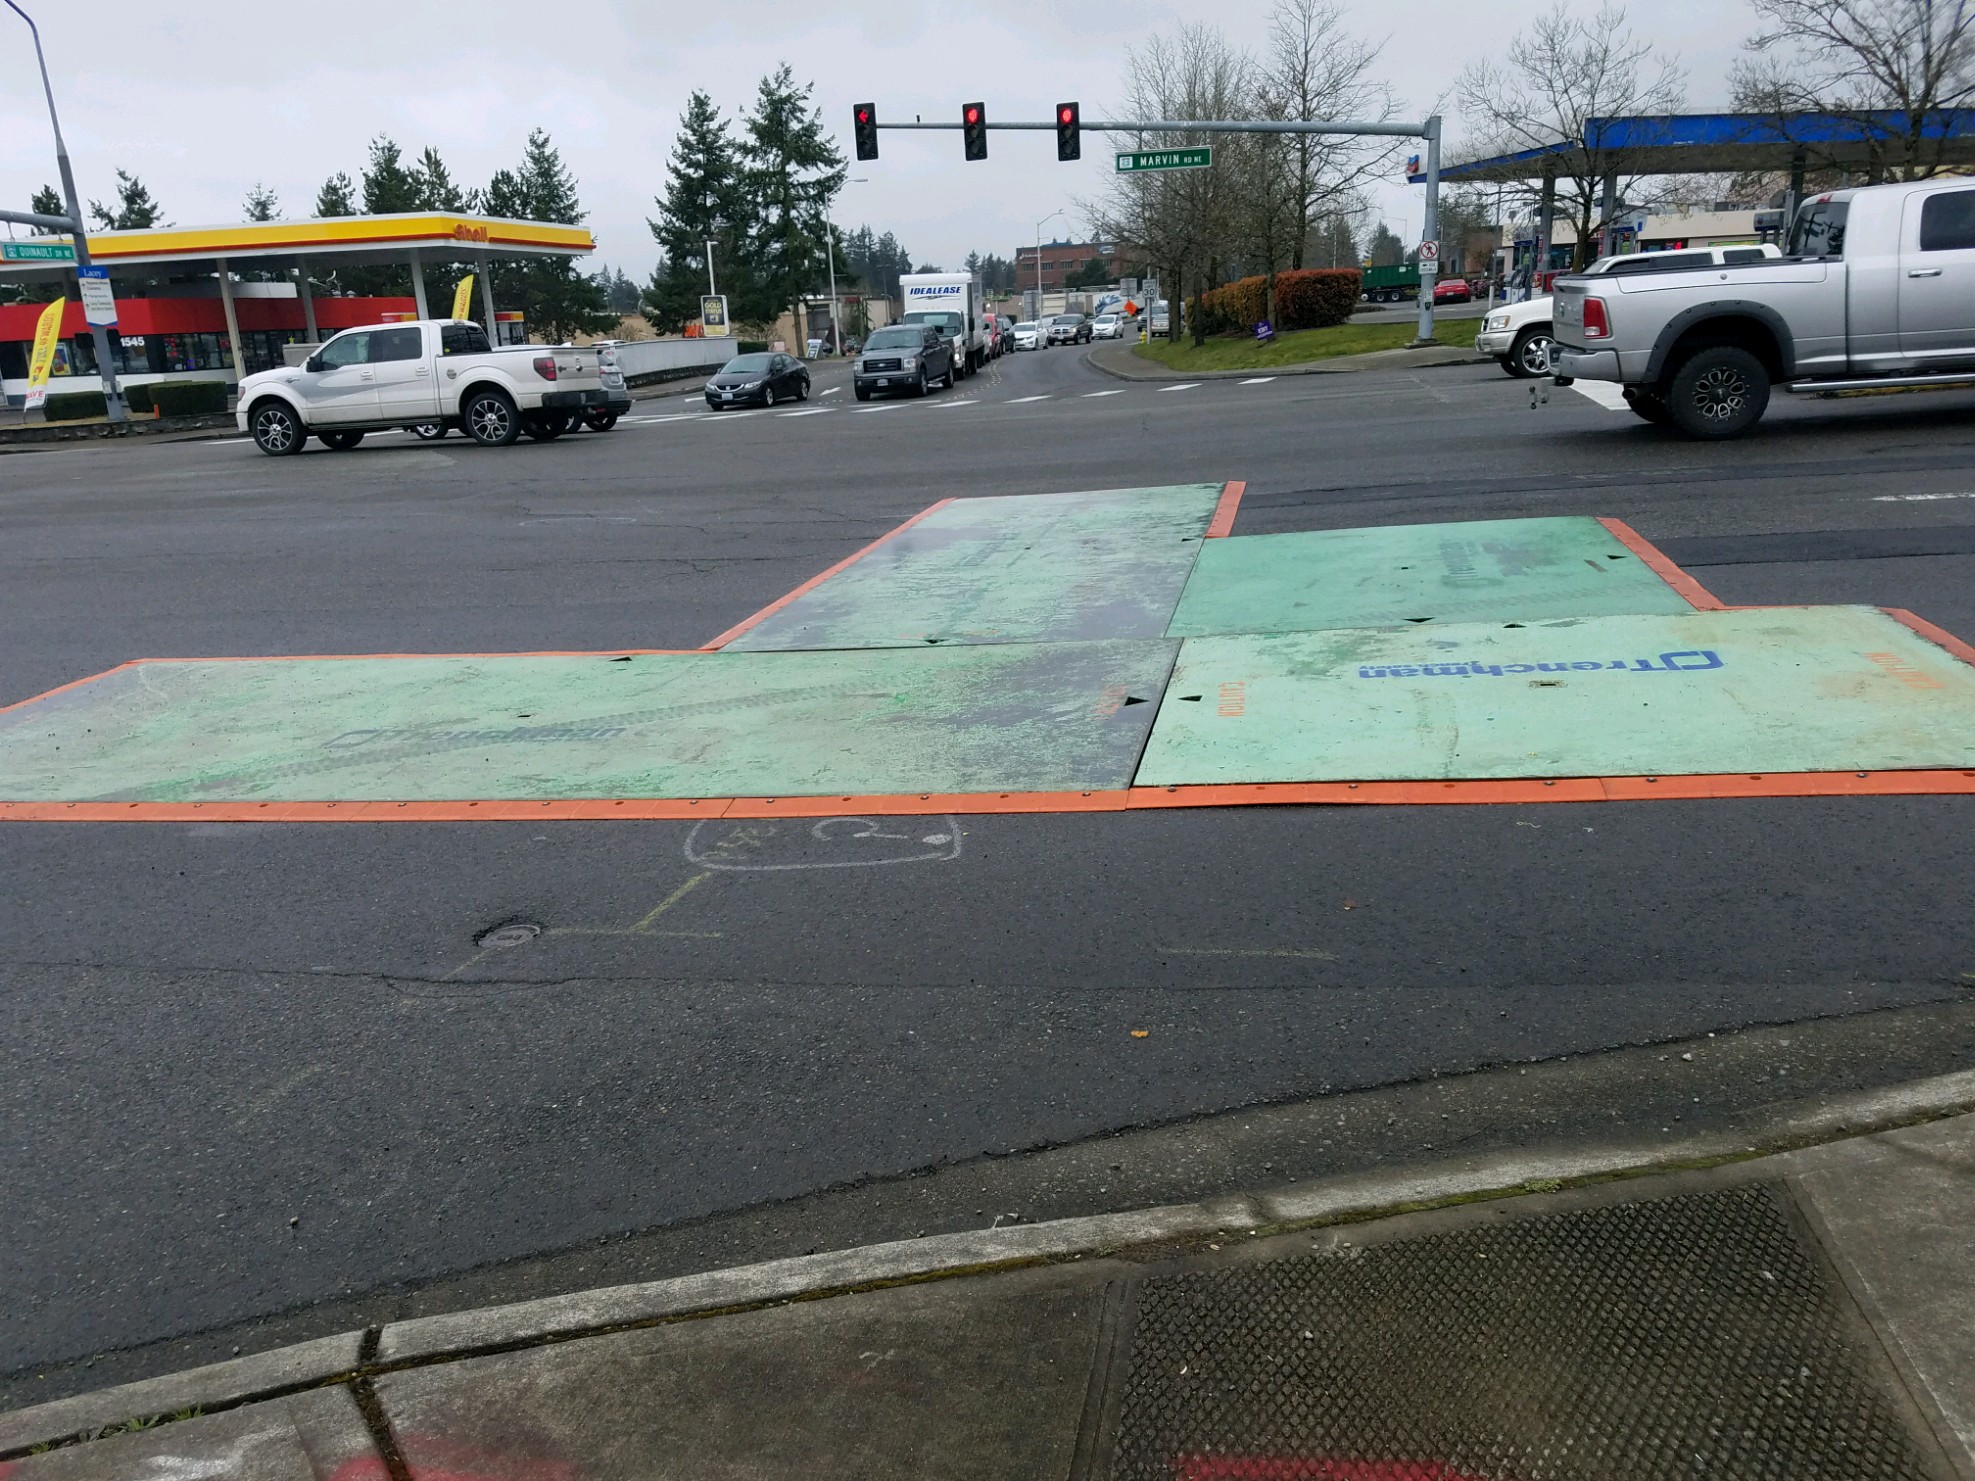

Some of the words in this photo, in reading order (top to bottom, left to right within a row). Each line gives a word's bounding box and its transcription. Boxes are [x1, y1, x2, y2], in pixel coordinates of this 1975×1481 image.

[1140, 154, 1179, 166] MARVIN
[455, 224, 488, 241] Shell
[20, 247, 52, 258] QUINAULT
[64, 249, 72, 258] NE
[83, 268, 102, 277] Lacey
[910, 286, 962, 295] IDEALEASE
[120, 336, 145, 347] 1545
[1359, 658, 1667, 679] Trenchman
